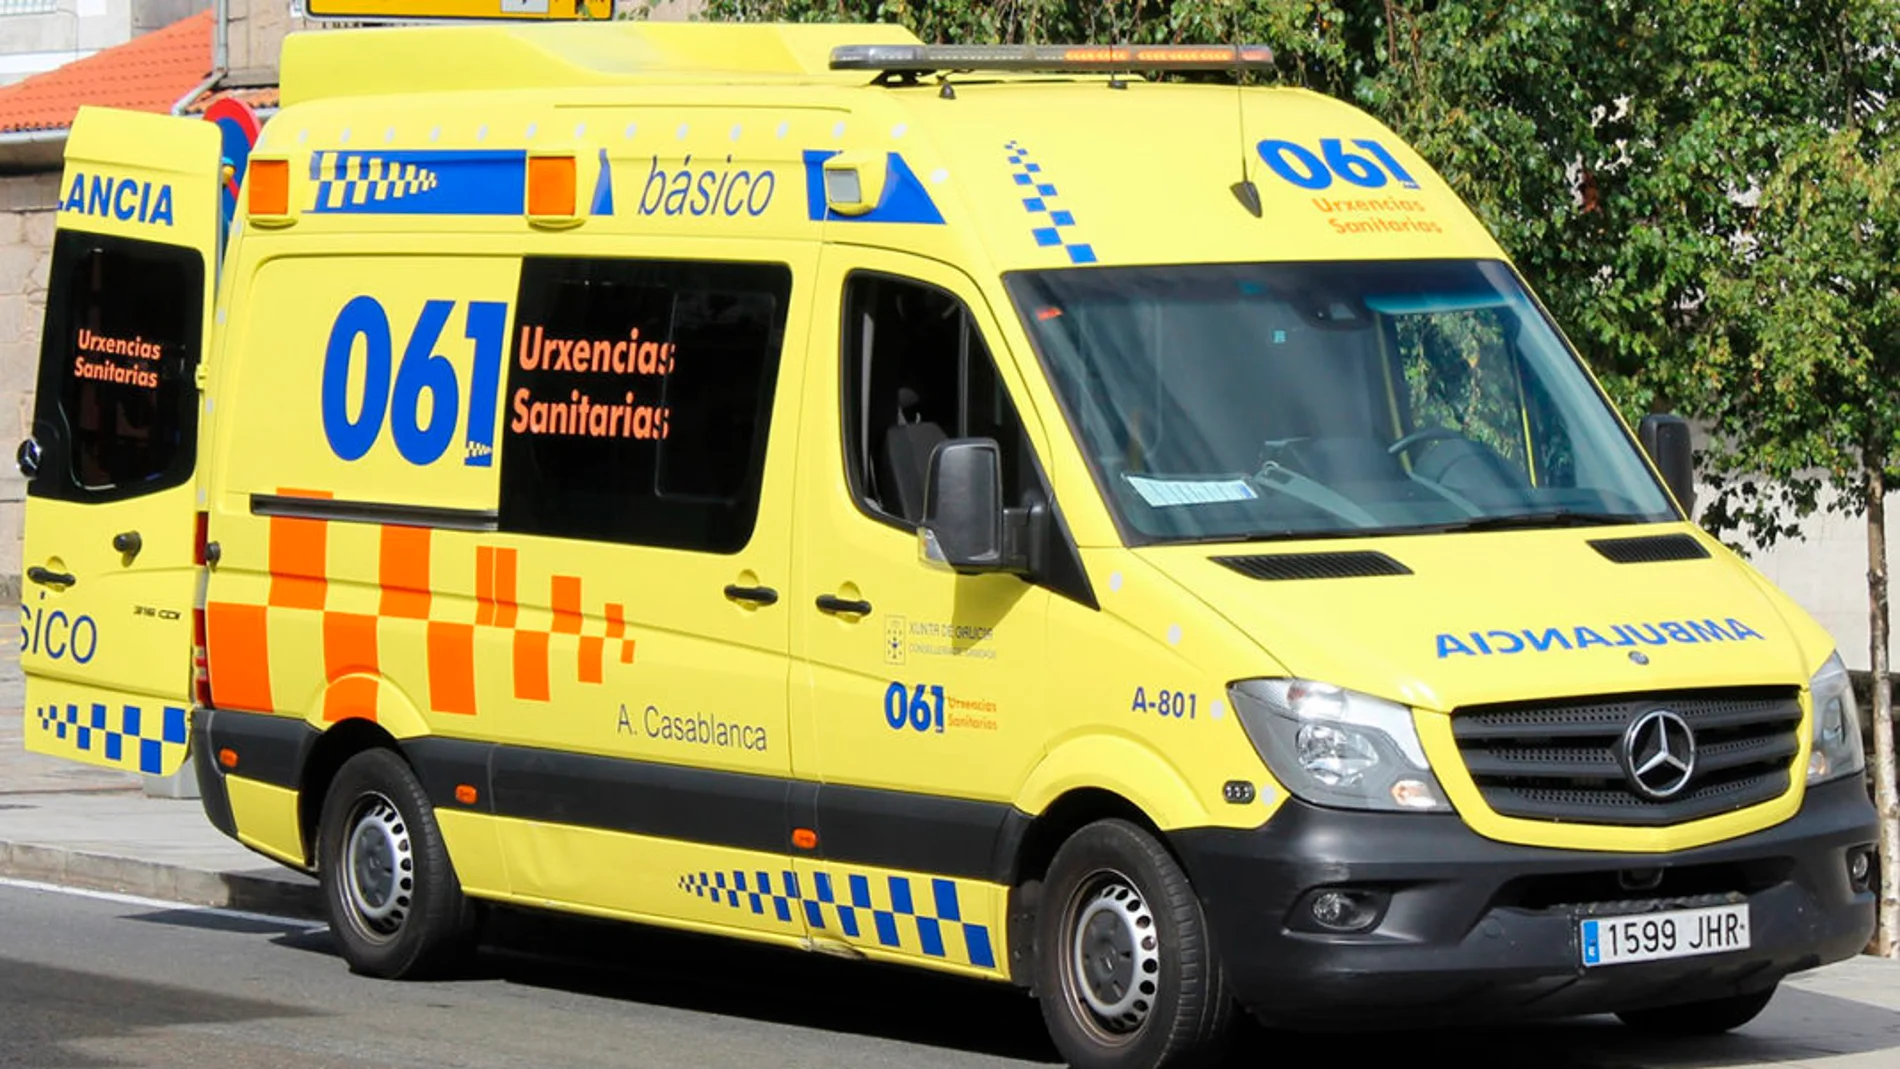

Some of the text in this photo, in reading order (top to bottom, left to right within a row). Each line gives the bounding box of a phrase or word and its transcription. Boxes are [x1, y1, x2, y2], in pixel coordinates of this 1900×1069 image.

[638, 154, 776, 216] básico
[1256, 138, 1421, 190] 061
[57, 172, 174, 227] ANCIA
[1311, 196, 1426, 213] Urxencias
[1328, 215, 1443, 235] Sanitarias
[77, 328, 162, 360] Urxencias
[518, 325, 676, 375] Urxencias
[74, 356, 159, 389] Sanitarias
[321, 294, 508, 468] 061
[511, 386, 670, 440] Sanitarias
[910, 622, 994, 642] XUNTA DE GALICIA
[884, 681, 944, 734] 061
[947, 696, 997, 713] Urxencias
[948, 713, 997, 732] Sanitarias
[1131, 686, 1197, 720] A-801
[616, 703, 767, 751] A. Casablanca
[1609, 912, 1739, 957] 1599 JHR
